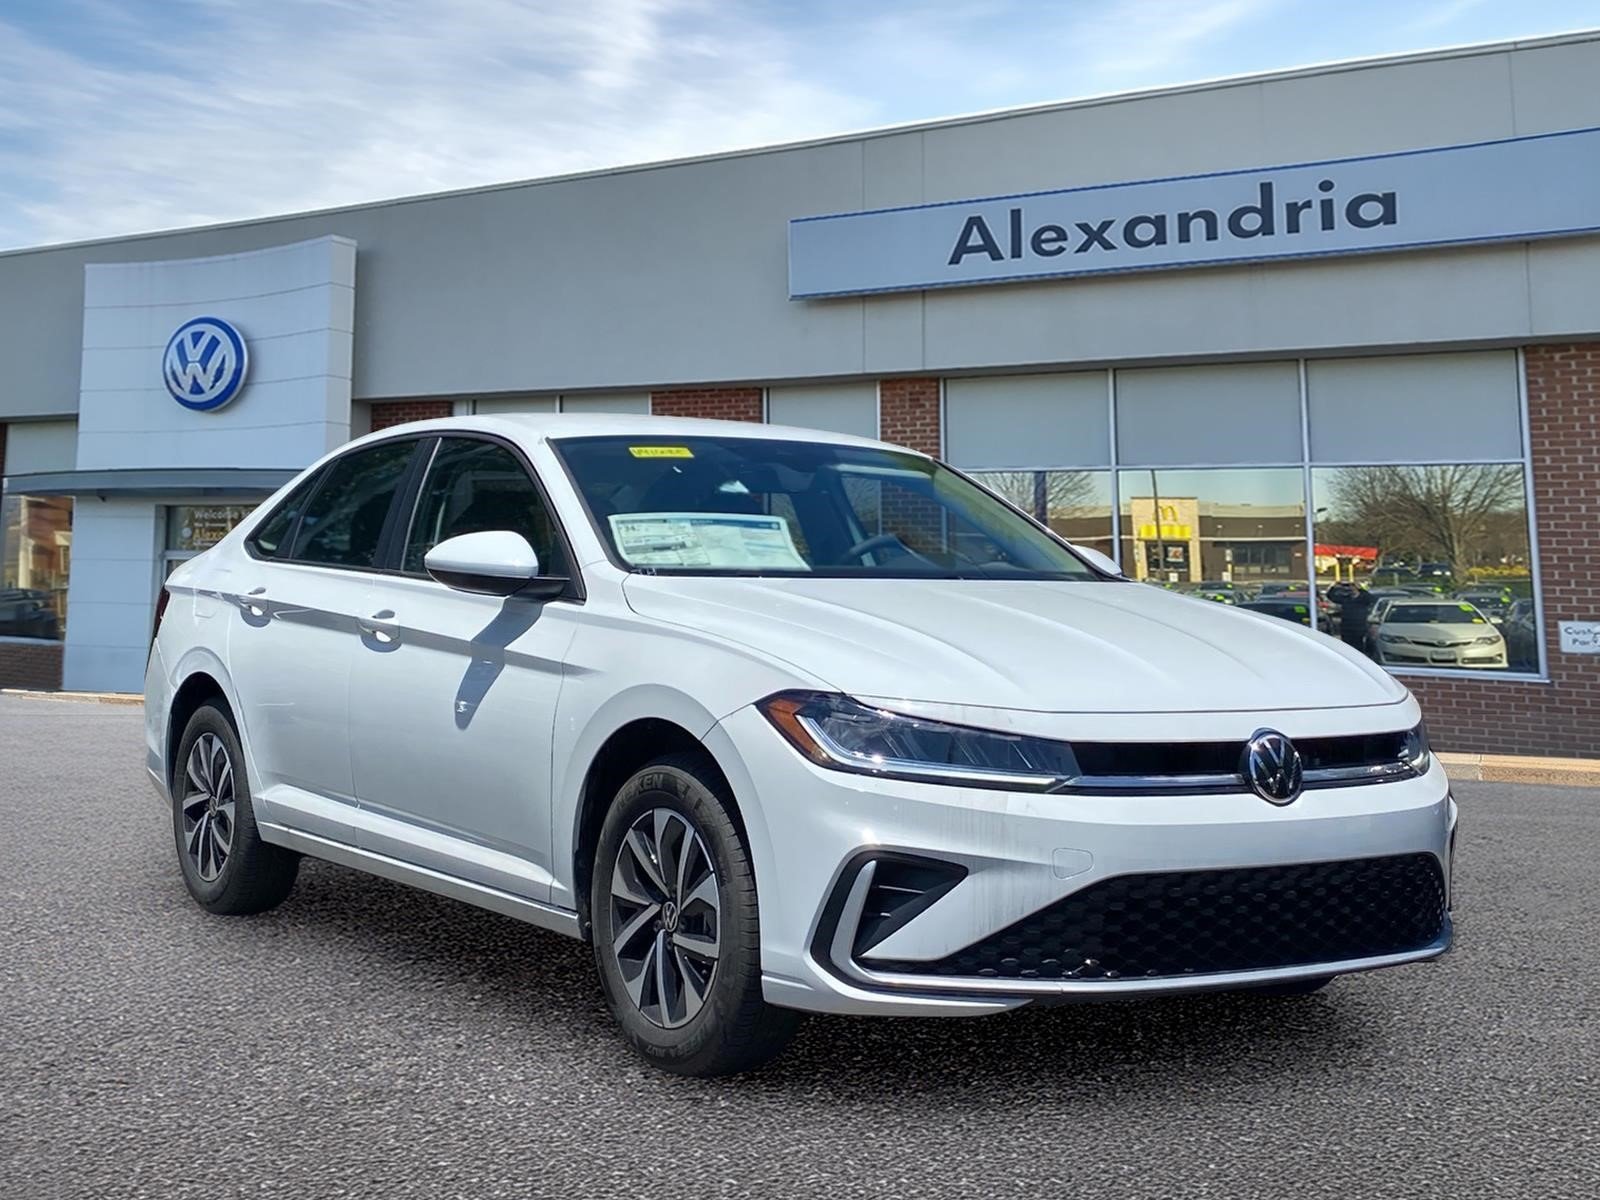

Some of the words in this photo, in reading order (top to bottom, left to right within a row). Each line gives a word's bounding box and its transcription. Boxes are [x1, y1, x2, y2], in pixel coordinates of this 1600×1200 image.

[948, 180, 1398, 265] Alexandria
[166, 321, 239, 404] VW
[617, 774, 663, 808] NEXEN
